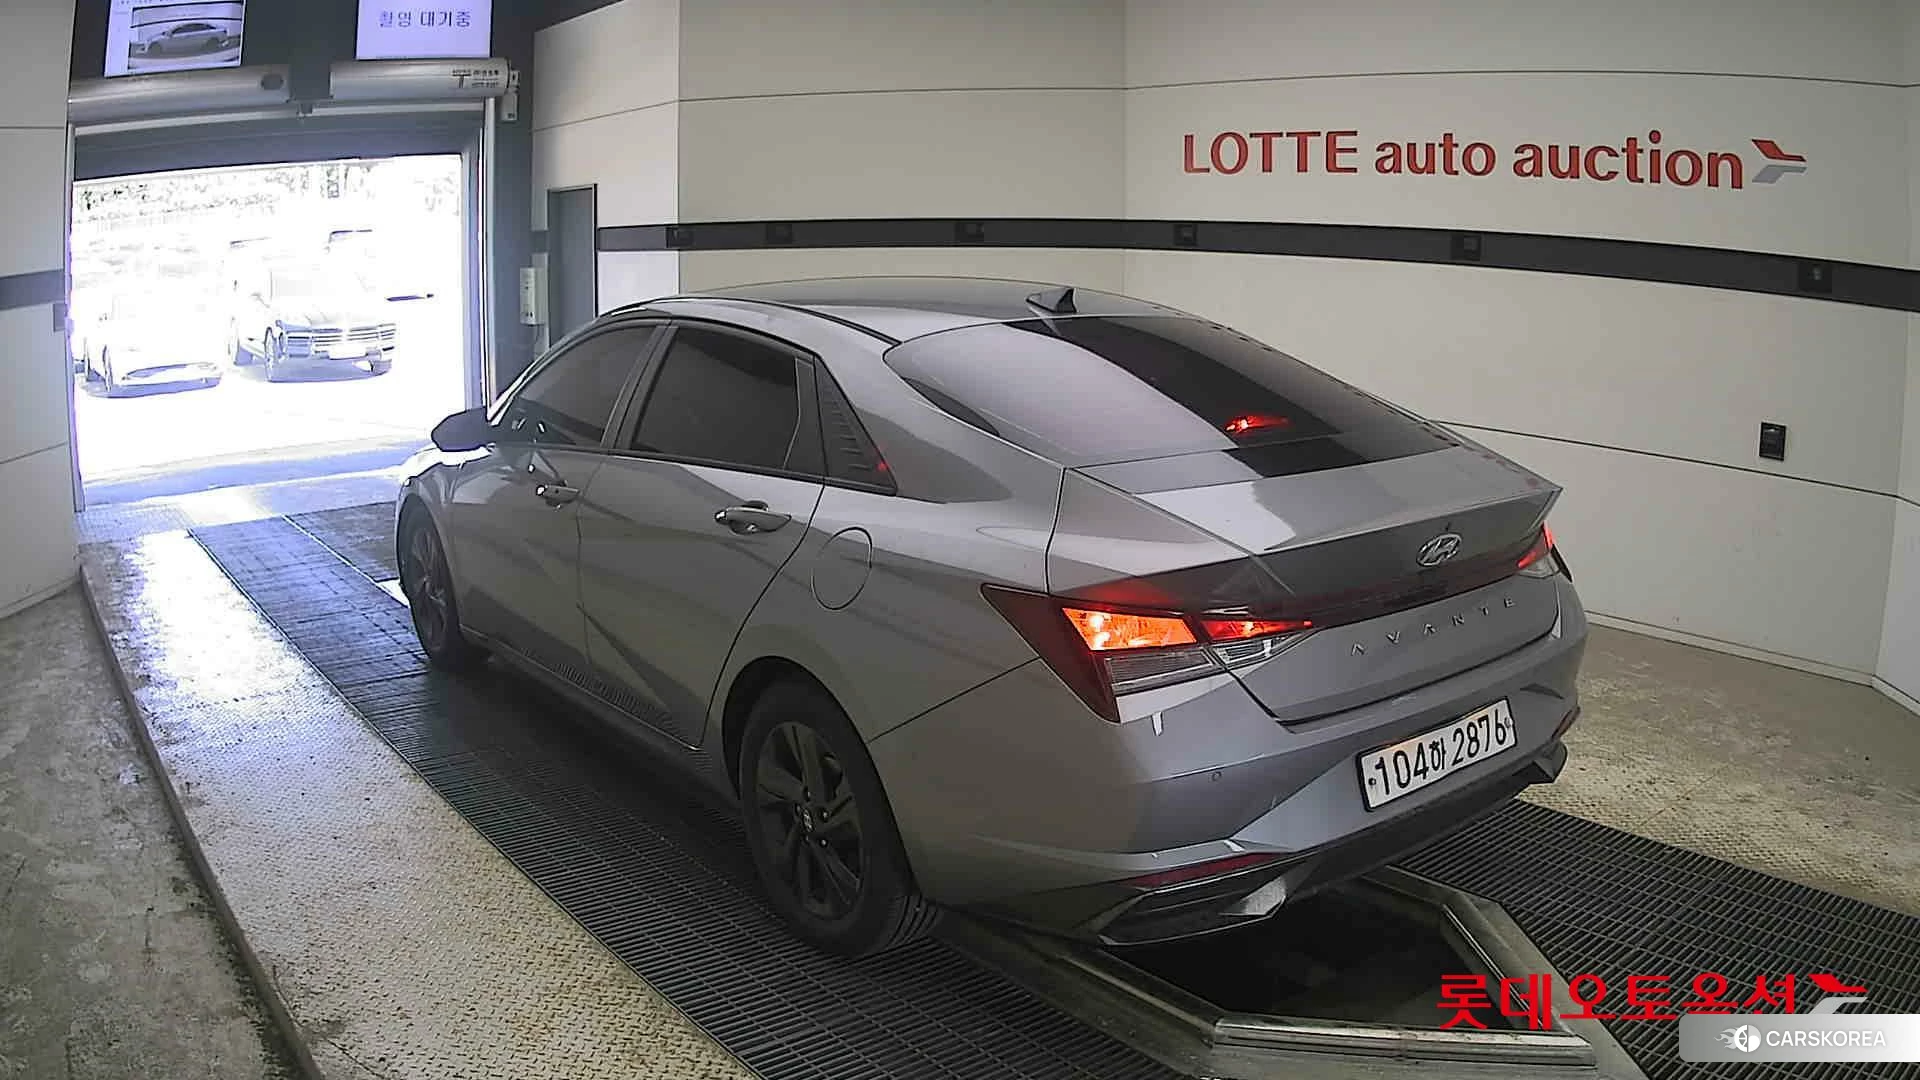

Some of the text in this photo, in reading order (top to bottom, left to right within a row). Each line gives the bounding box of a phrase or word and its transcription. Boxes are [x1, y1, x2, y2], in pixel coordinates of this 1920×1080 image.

[420, 10, 471, 28] 대기중
[1184, 130, 1744, 189] LOTTE auto auction
[1351, 598, 1515, 656] AVANTE
[1451, 709, 1507, 766] 2876
